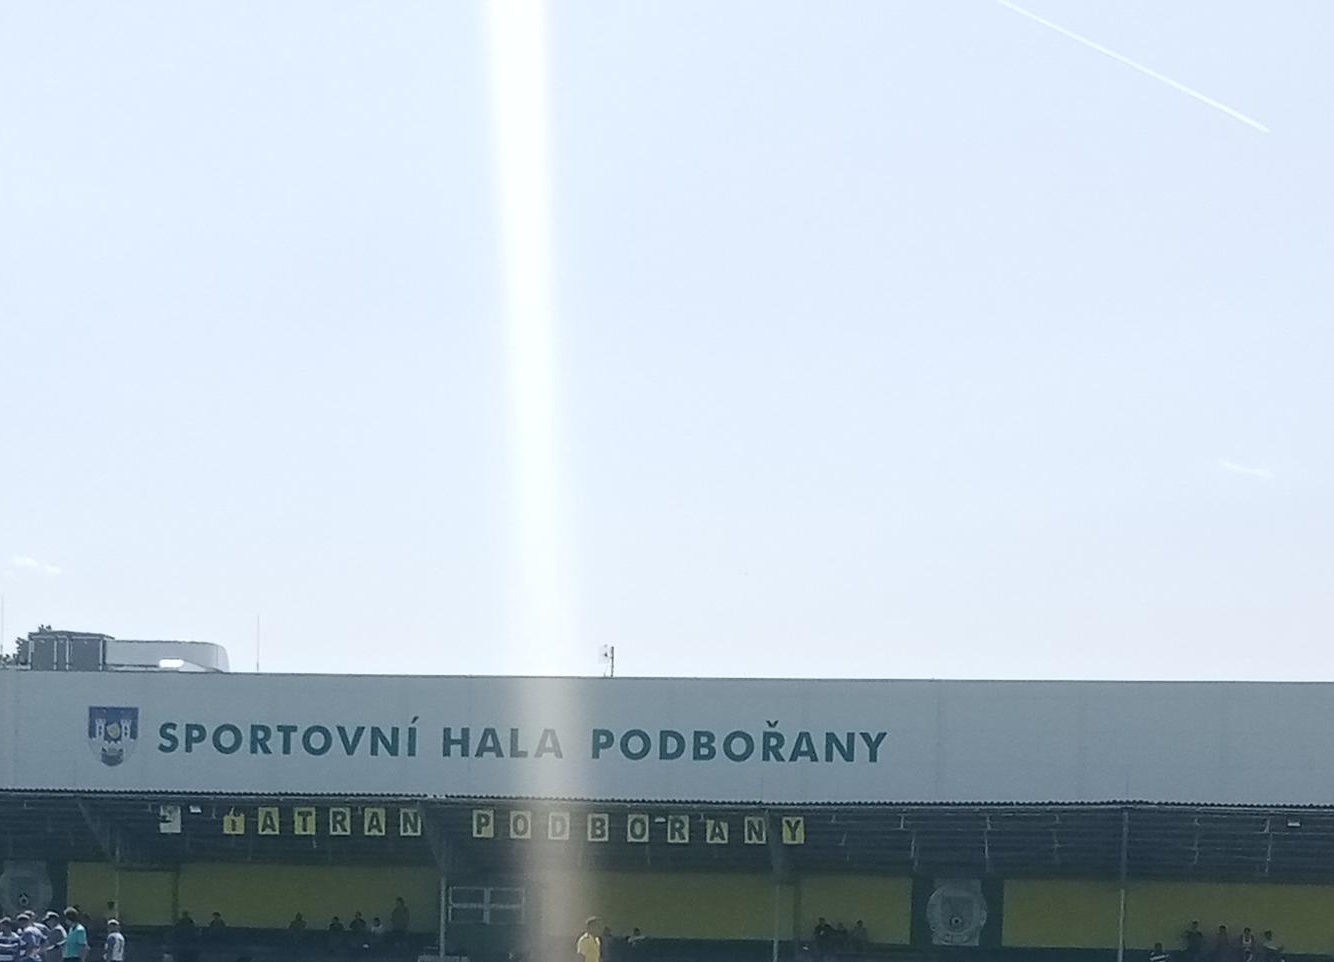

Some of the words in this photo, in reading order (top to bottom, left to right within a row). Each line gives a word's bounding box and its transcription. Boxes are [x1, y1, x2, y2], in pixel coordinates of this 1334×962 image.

[157, 716, 419, 757] SPORTOVNÍ
[442, 727, 564, 759] HALA
[591, 720, 887, 764] PODBOŘANY
